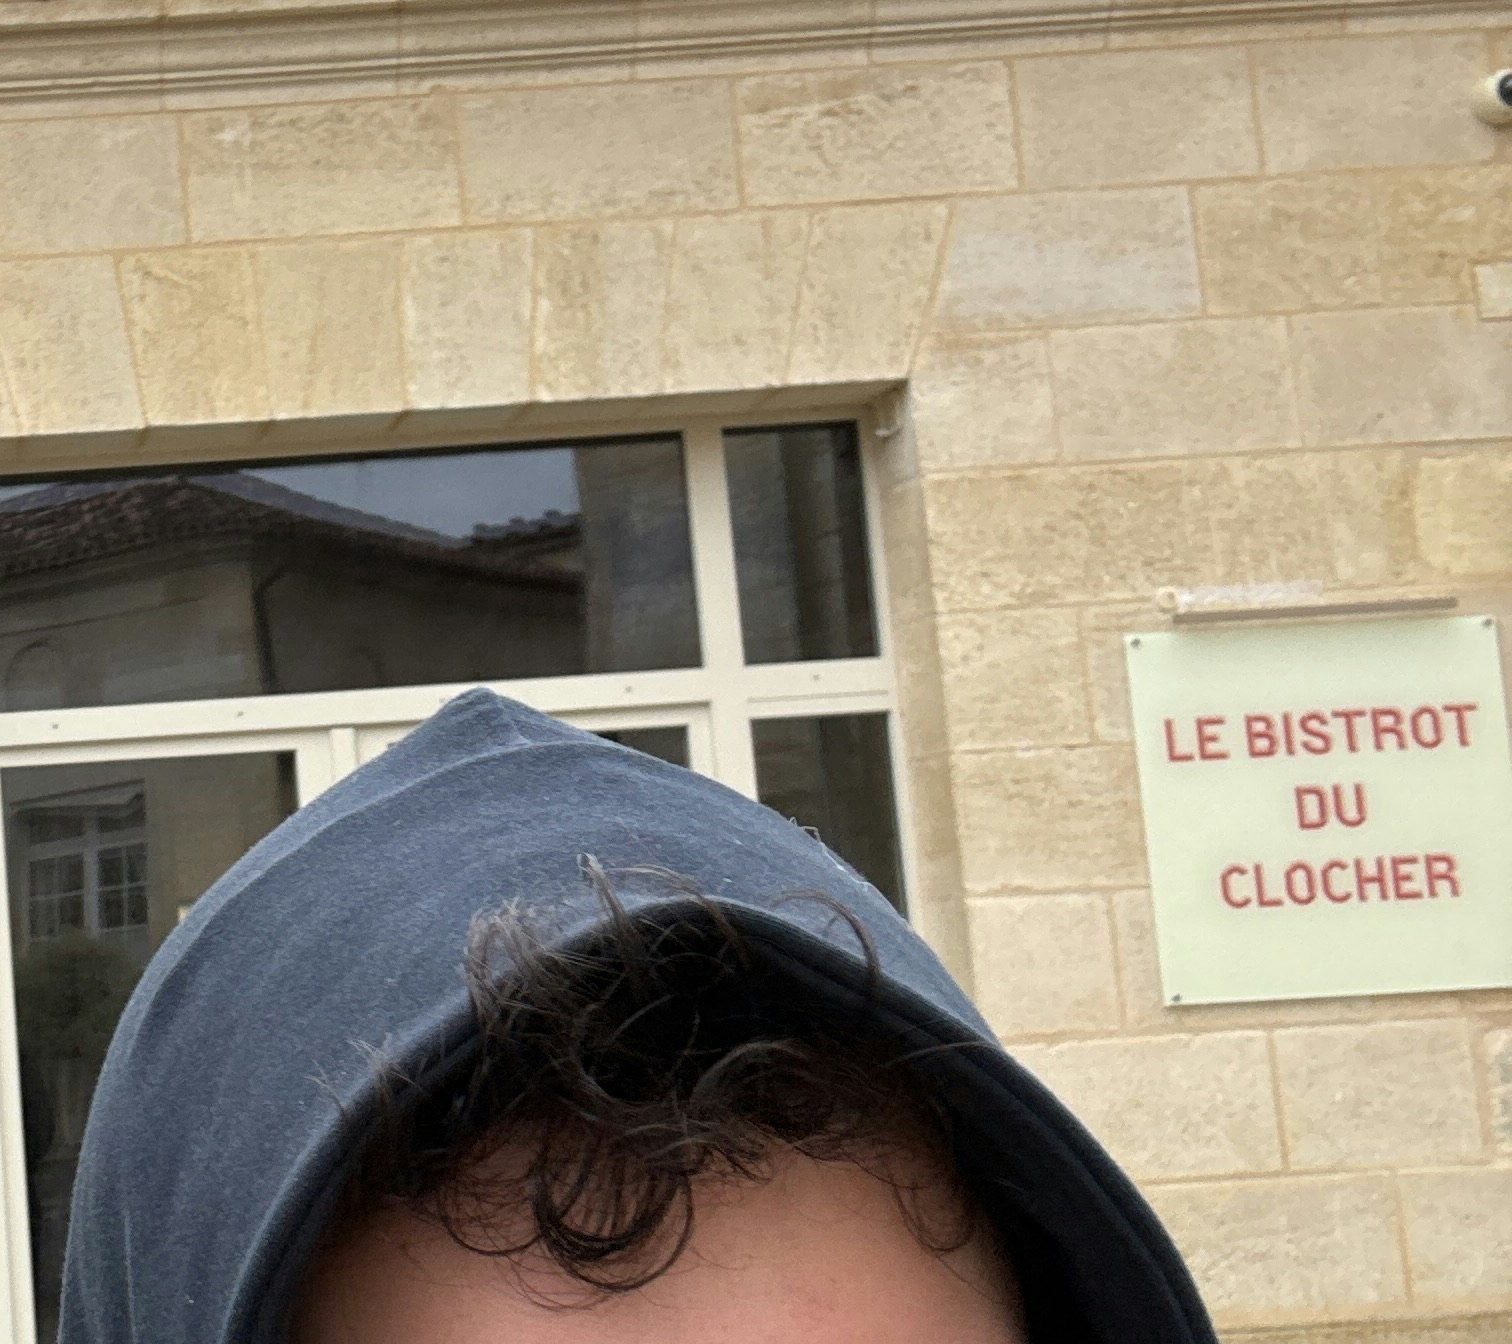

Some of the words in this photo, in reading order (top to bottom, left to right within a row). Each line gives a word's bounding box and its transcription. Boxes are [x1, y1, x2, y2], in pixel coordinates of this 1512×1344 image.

[1164, 715, 1230, 763] LE
[1244, 702, 1479, 760] BISTROT
[1294, 783, 1368, 831] DU
[1219, 852, 1462, 910] CLOCHER
